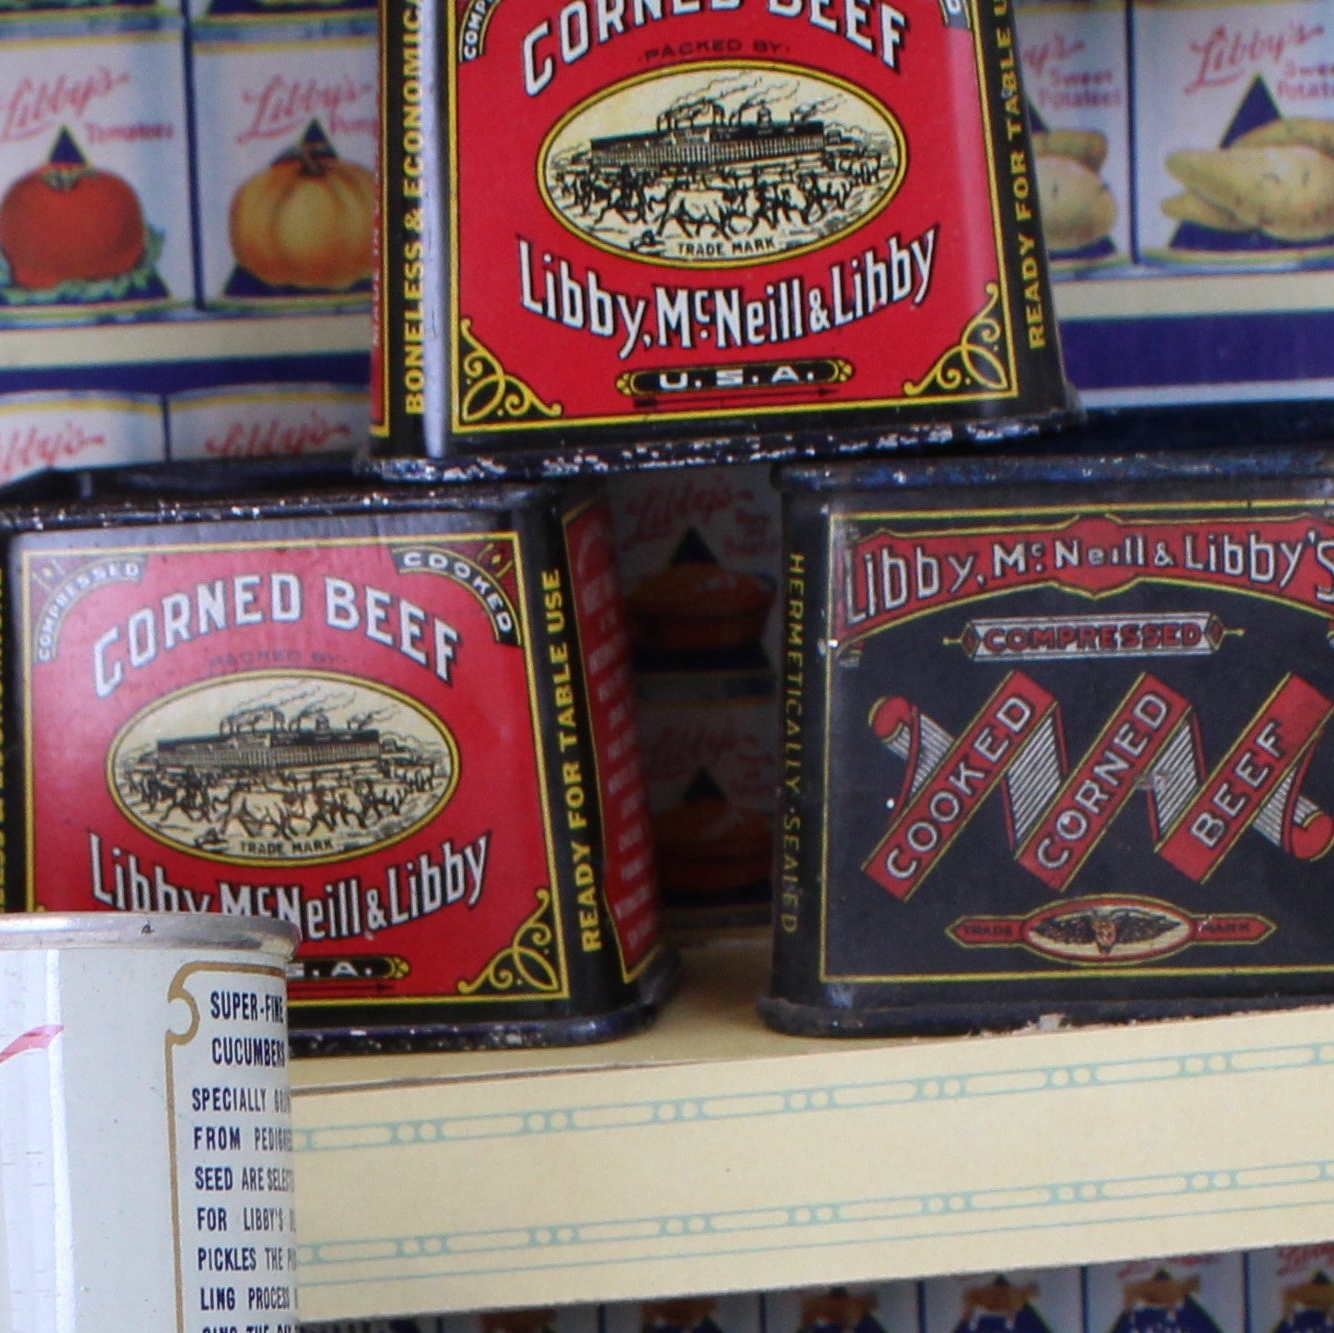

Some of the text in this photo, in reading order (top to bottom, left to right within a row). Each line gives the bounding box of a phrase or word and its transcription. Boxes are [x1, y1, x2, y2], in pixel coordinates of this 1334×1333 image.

[1184, 22, 1325, 95] Libby's
[995, 28, 1047, 350] READY FOR TABLE
[677, 236, 776, 257] TRADE MARK
[807, 288, 832, 332] &
[830, 225, 941, 328] Libby
[404, 207, 425, 415] BONELESS &
[402, 550, 514, 636] COOKED
[1153, 543, 1175, 568] &
[37, 560, 142, 661] COMPRESSED
[94, 573, 303, 698] CORNED
[324, 576, 463, 688] BEEF
[983, 625, 1202, 650] COMPRESSED
[541, 569, 602, 952] READY FOR TABLE USE
[781, 552, 806, 935] HERMETICALLY SEALED
[884, 696, 1033, 882] COOKED
[1034, 690, 1170, 871] CORNED
[1189, 725, 1287, 846] BEEF
[385, 830, 493, 915] Libby
[192, 1086, 267, 1113] SPECIALLY
[194, 1125, 242, 1151] FROM
[198, 1246, 258, 1273] PICKLES
